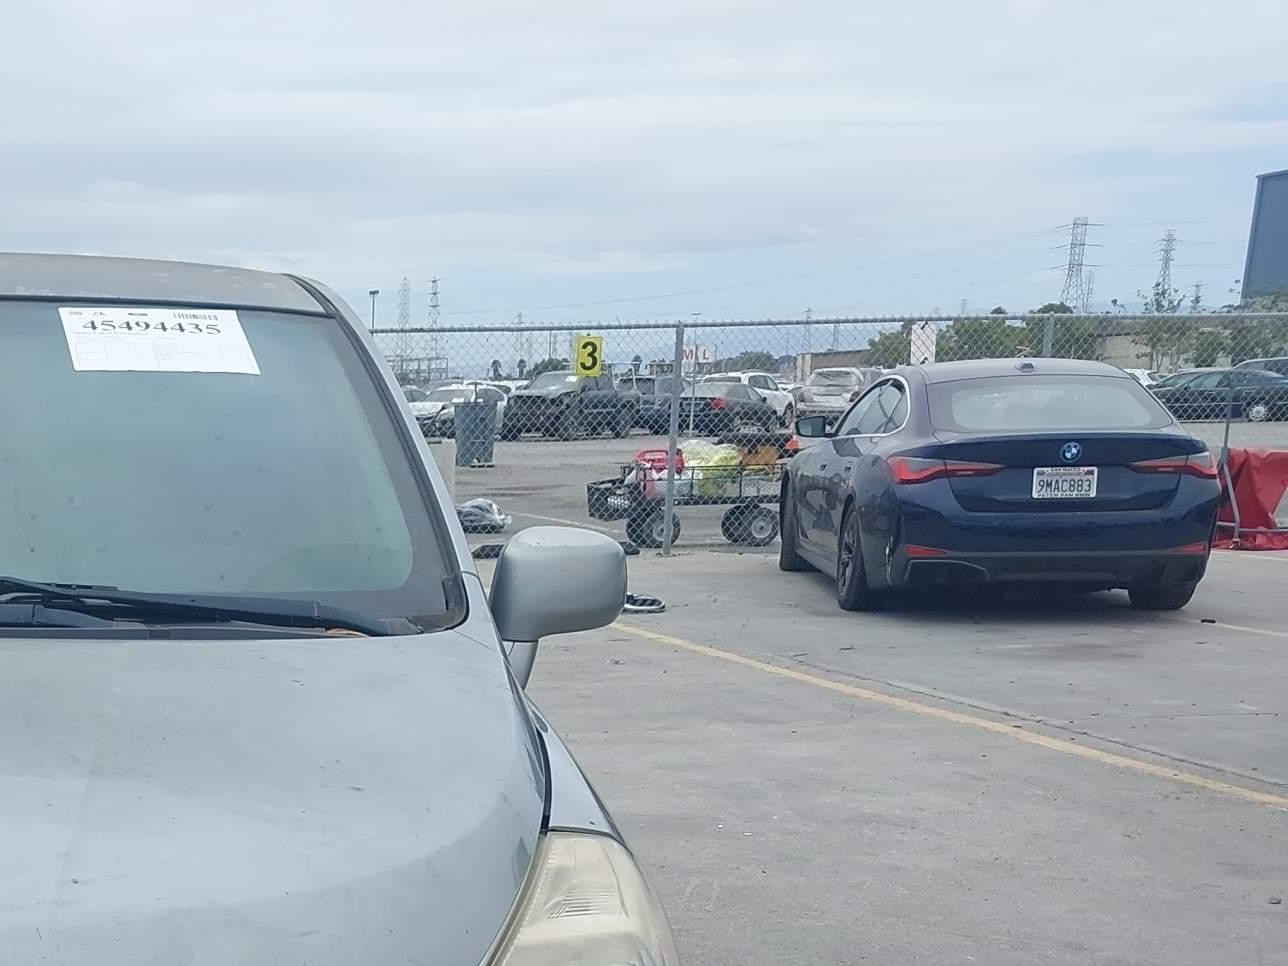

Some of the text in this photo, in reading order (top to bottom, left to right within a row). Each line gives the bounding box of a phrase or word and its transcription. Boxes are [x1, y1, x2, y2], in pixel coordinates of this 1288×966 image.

[83, 319, 222, 335] 45494435
[580, 341, 598, 371] 3
[1038, 478, 1092, 493] 9MAC883
